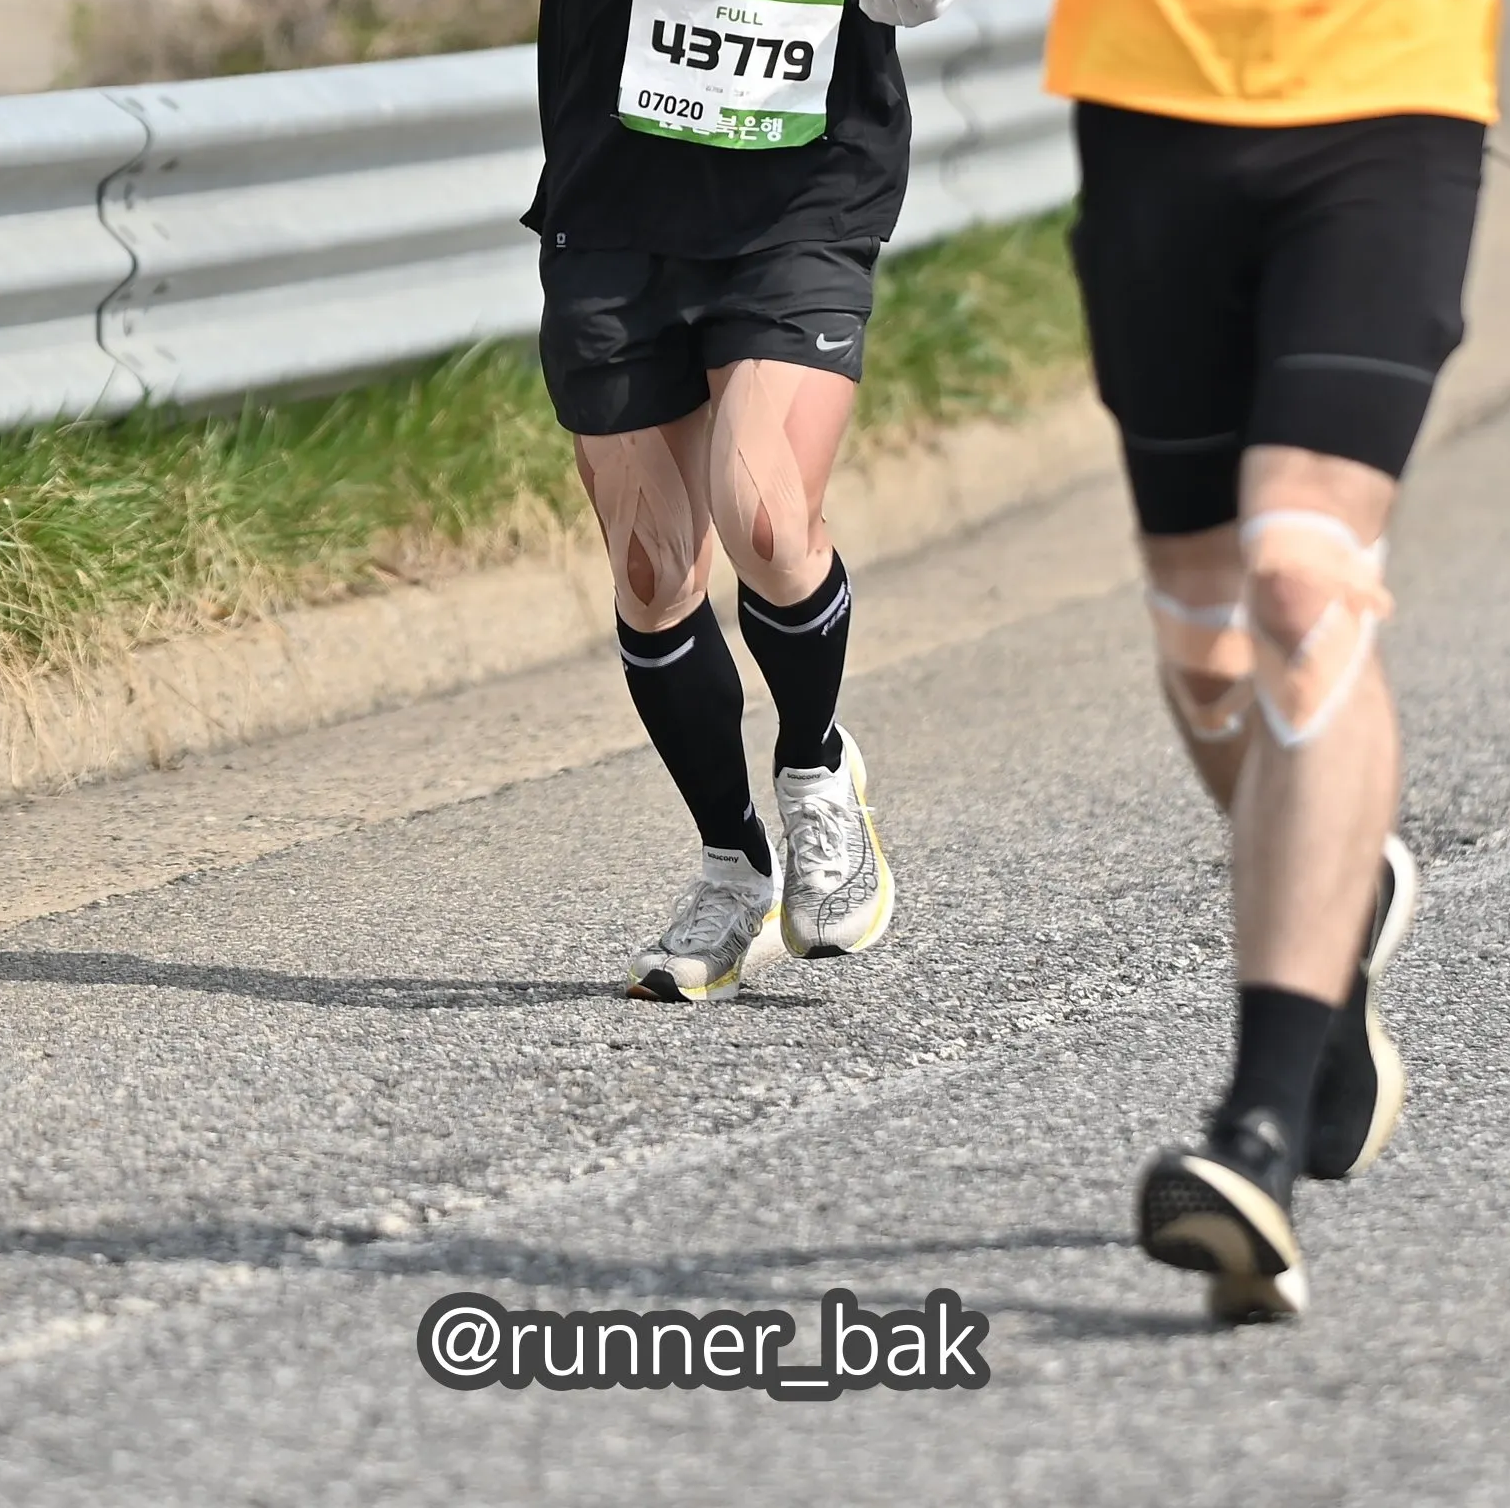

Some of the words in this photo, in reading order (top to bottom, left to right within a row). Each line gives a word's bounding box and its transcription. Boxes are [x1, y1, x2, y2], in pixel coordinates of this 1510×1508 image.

[716, 6, 763, 26] FULL
[652, 19, 814, 82] 43779
[638, 90, 704, 121] 07020
